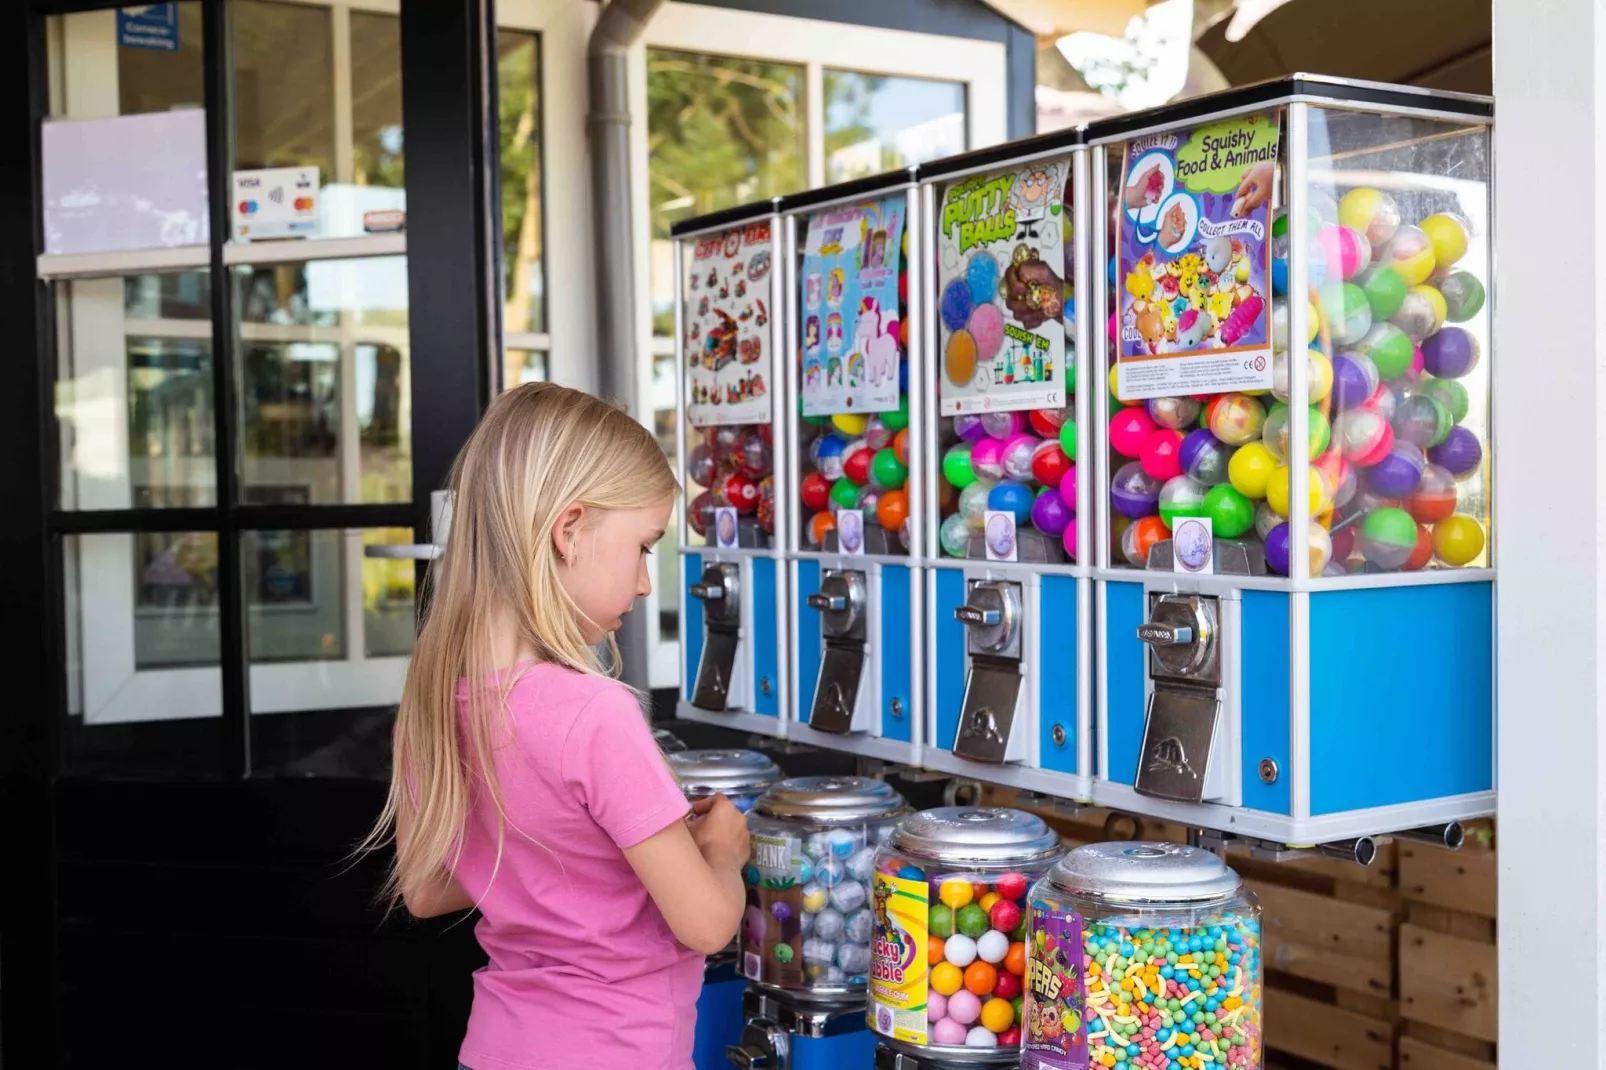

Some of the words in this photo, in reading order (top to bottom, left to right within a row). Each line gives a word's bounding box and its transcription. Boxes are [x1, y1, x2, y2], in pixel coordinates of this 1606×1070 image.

[1202, 128, 1255, 158] Squishy
[1177, 152, 1208, 177] Food
[1210, 156, 1222, 170] &
[1224, 141, 1277, 168] Animals
[238, 178, 261, 188] VISA
[943, 173, 1017, 240] PUTTY
[959, 208, 1017, 255] BALLS
[1200, 220, 1225, 236] COLLECT
[1228, 220, 1248, 233] THEM
[1250, 222, 1262, 238] ALL
[1004, 323, 1034, 345] SQUISH
[756, 844, 786, 870] BANK
[1051, 1045, 1067, 1056] CANDY
